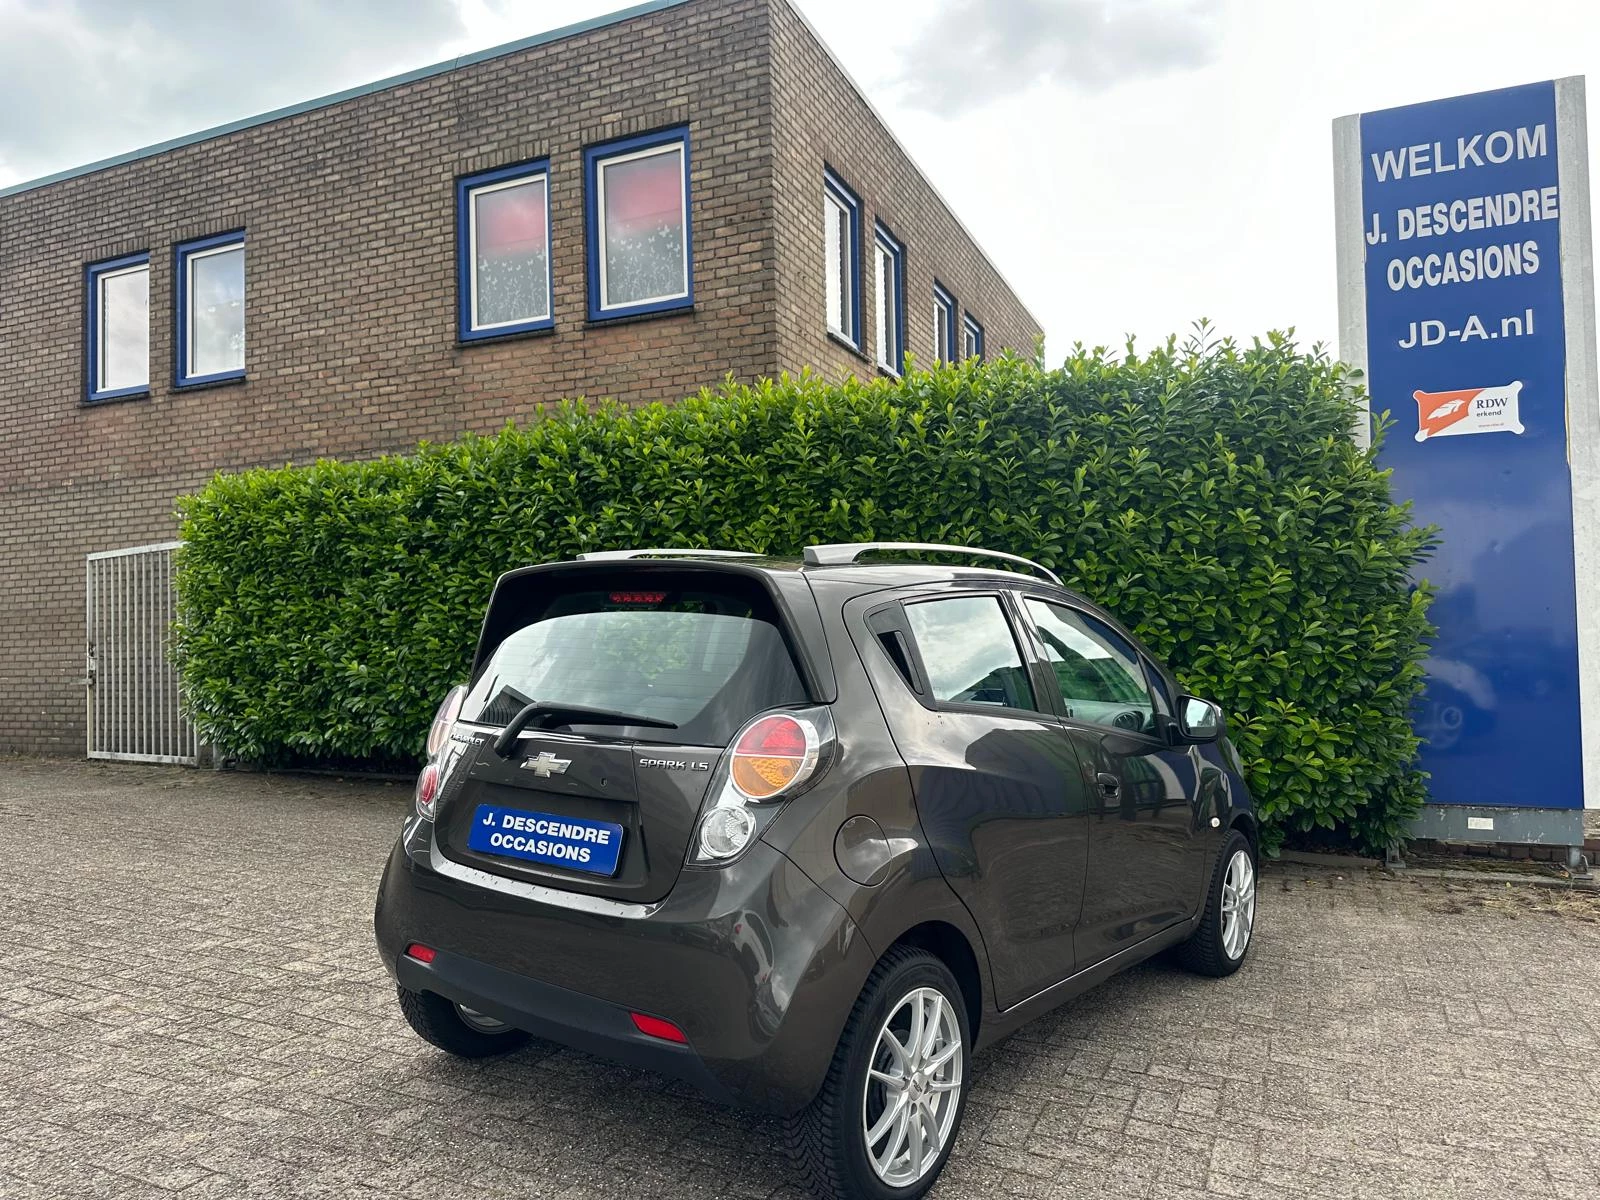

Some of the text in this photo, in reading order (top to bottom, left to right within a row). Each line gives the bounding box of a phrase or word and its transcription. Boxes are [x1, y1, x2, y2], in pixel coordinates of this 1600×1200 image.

[1371, 124, 1547, 182] WELKOM
[1366, 186, 1559, 245] J. DESCENDRE
[1387, 240, 1540, 291] OCCASIONS
[1398, 309, 1534, 349] JD-A.nl
[1476, 397, 1508, 409] RDW
[639, 758, 709, 771] SPARK LS
[482, 812, 611, 844] J. DESCENDRE
[490, 832, 591, 863] OCCASIONS
